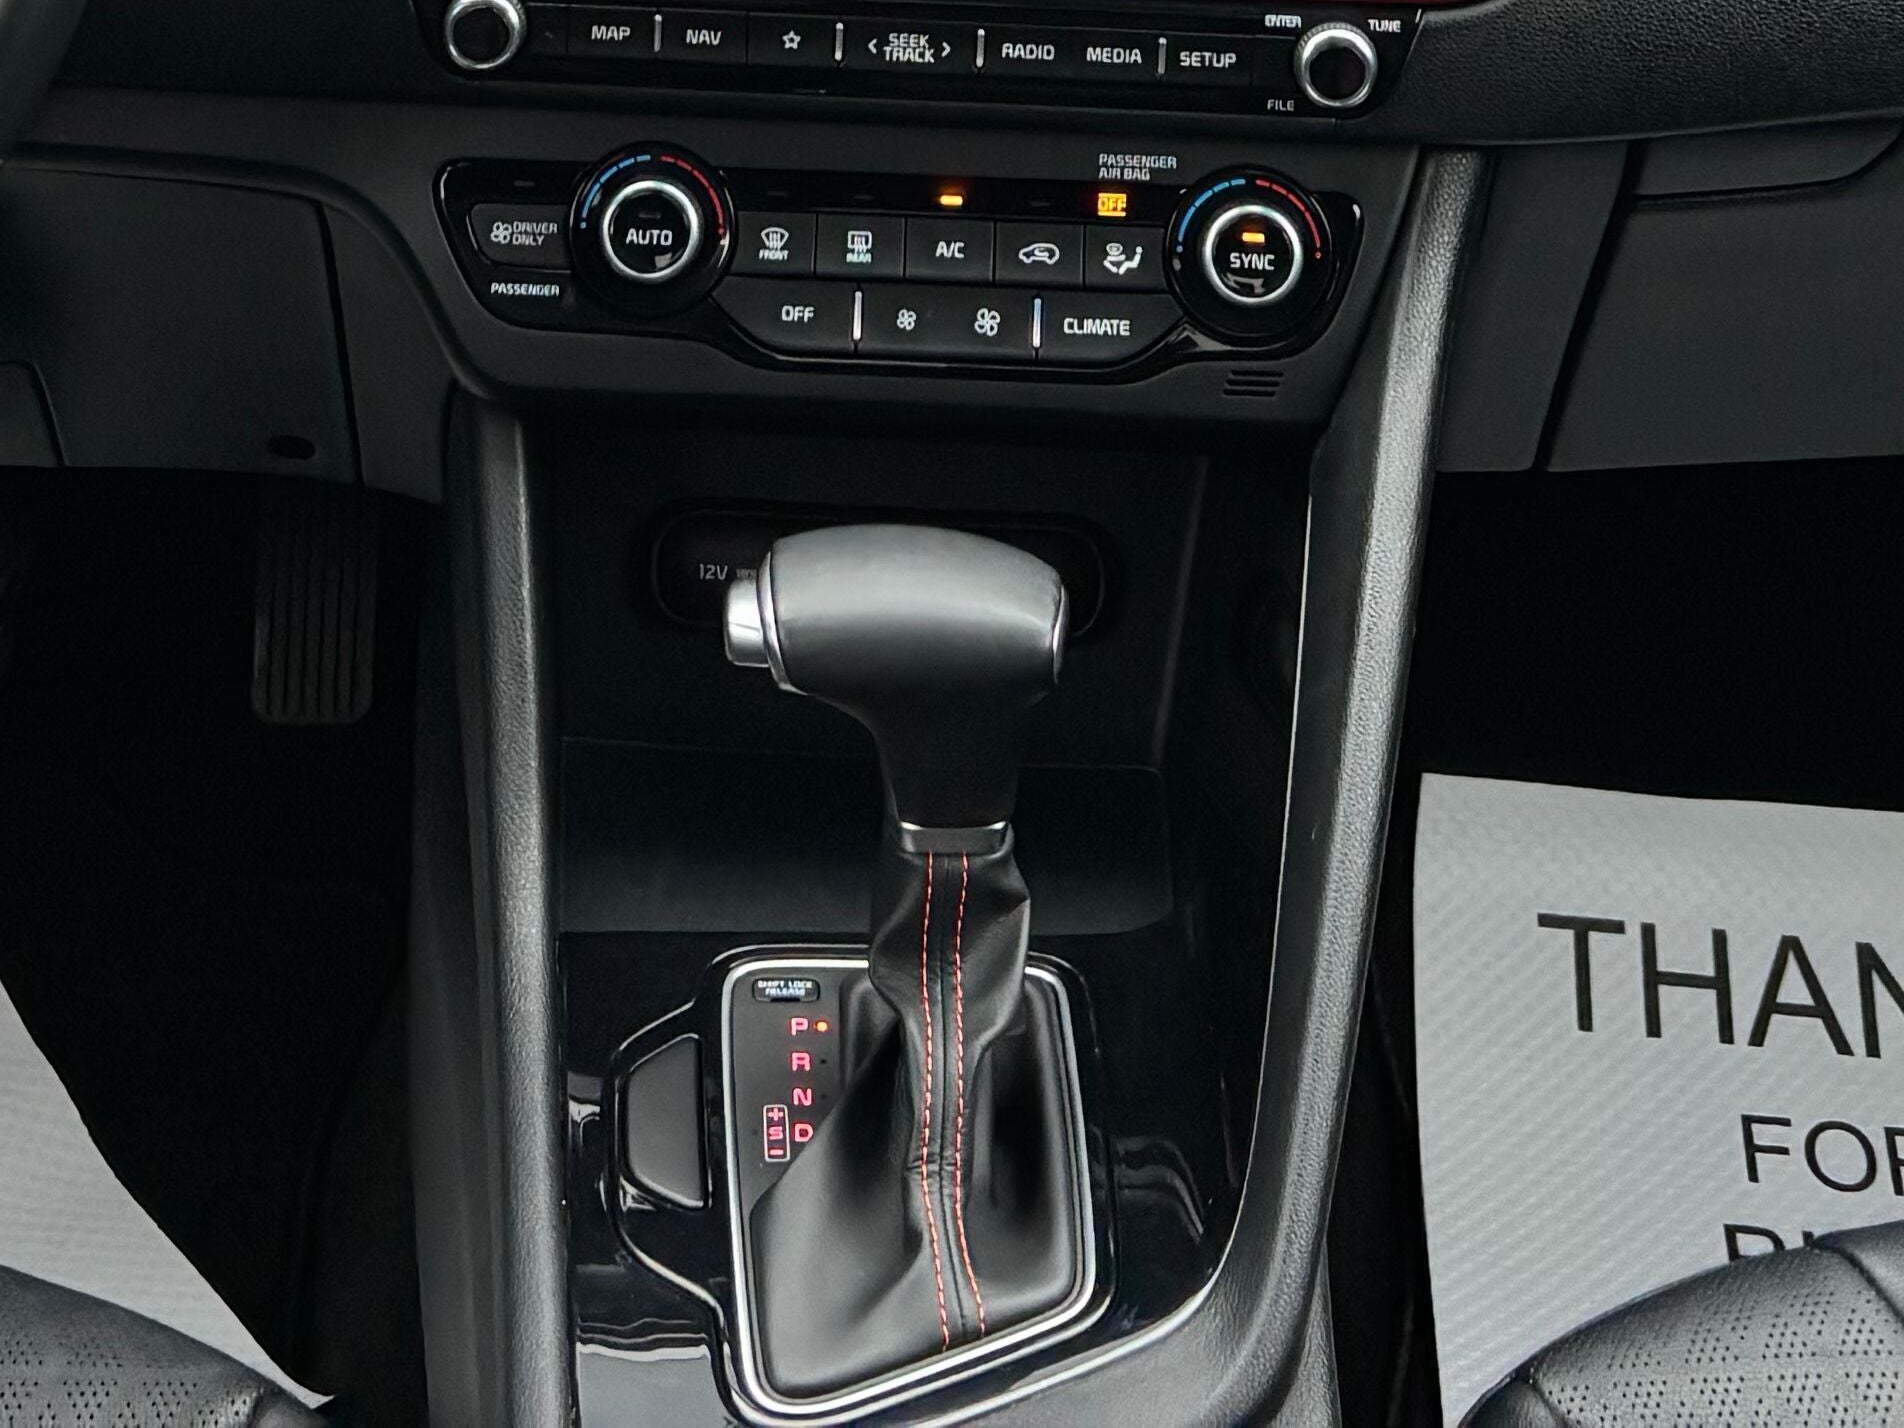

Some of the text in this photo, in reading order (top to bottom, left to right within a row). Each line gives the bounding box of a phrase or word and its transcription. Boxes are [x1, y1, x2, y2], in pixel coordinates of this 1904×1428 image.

[1264, 14, 1301, 28] ENTER
[1367, 18, 1402, 33] TUNE
[591, 24, 631, 41] MAP
[686, 29, 722, 46] NAV
[888, 32, 929, 48] SEEK
[882, 46, 935, 64] TRACK
[1001, 43, 1055, 61] RADIO
[1086, 46, 1142, 64] MEDIA
[1179, 51, 1237, 68] SETUP
[1267, 99, 1295, 112] FILE
[1098, 153, 1177, 169] PASSENGER
[1098, 167, 1150, 181] AIR BAG
[1098, 196, 1127, 212] OFF
[512, 221, 558, 234] DRIVER
[512, 234, 544, 246] ONLY
[625, 227, 673, 246] AUTO
[758, 248, 789, 261] FRONT
[846, 252, 872, 263] REAR
[935, 240, 965, 259] A/C
[1230, 252, 1275, 270] SYNC
[490, 282, 560, 297] PASSENGER
[781, 305, 814, 323] OFF
[1063, 317, 1130, 337] CLIMATE
[699, 563, 729, 581] 12V
[790, 1017, 809, 1036] P
[791, 1052, 811, 1071] R
[793, 1088, 812, 1106] N
[768, 1126, 784, 1141] S
[794, 1123, 814, 1143] D
